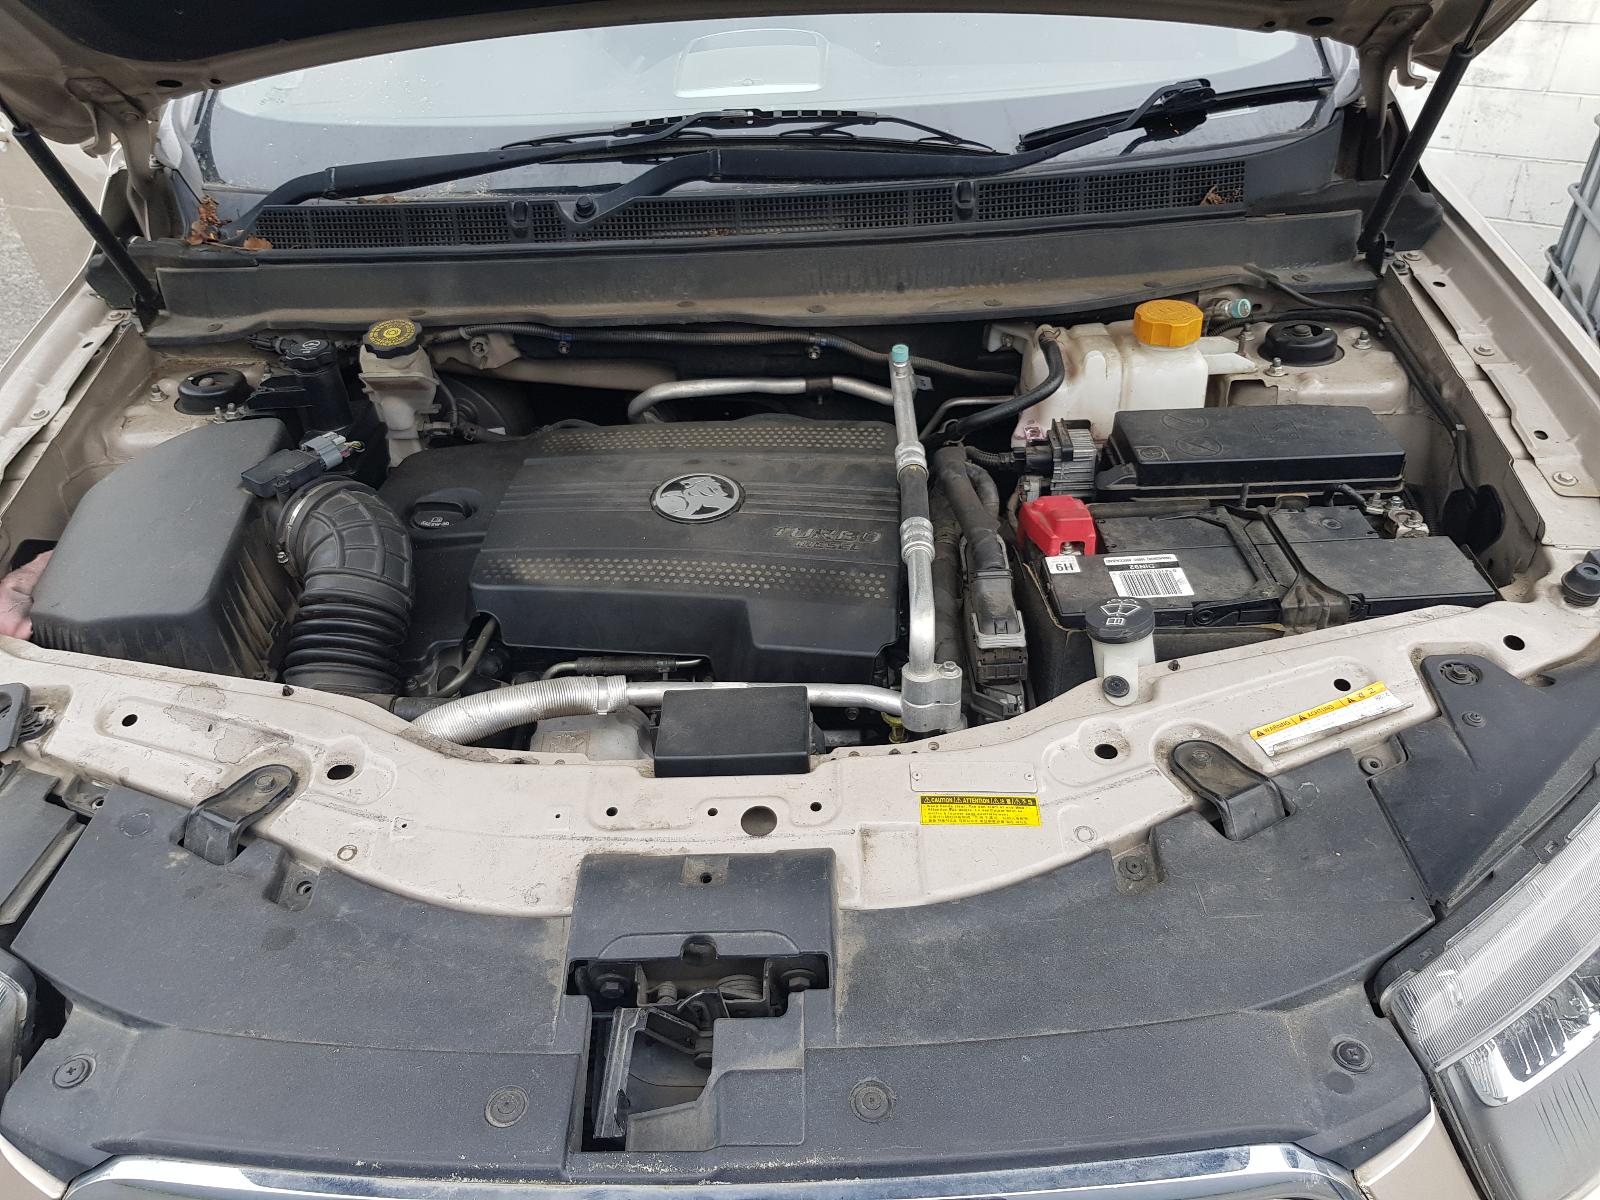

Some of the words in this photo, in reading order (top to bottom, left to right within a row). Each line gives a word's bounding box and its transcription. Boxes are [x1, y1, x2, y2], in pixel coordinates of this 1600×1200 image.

[772, 527, 882, 543] TURBO
[1263, 720, 1291, 734] WARNING
[1307, 704, 1335, 718] ACHTUNG
